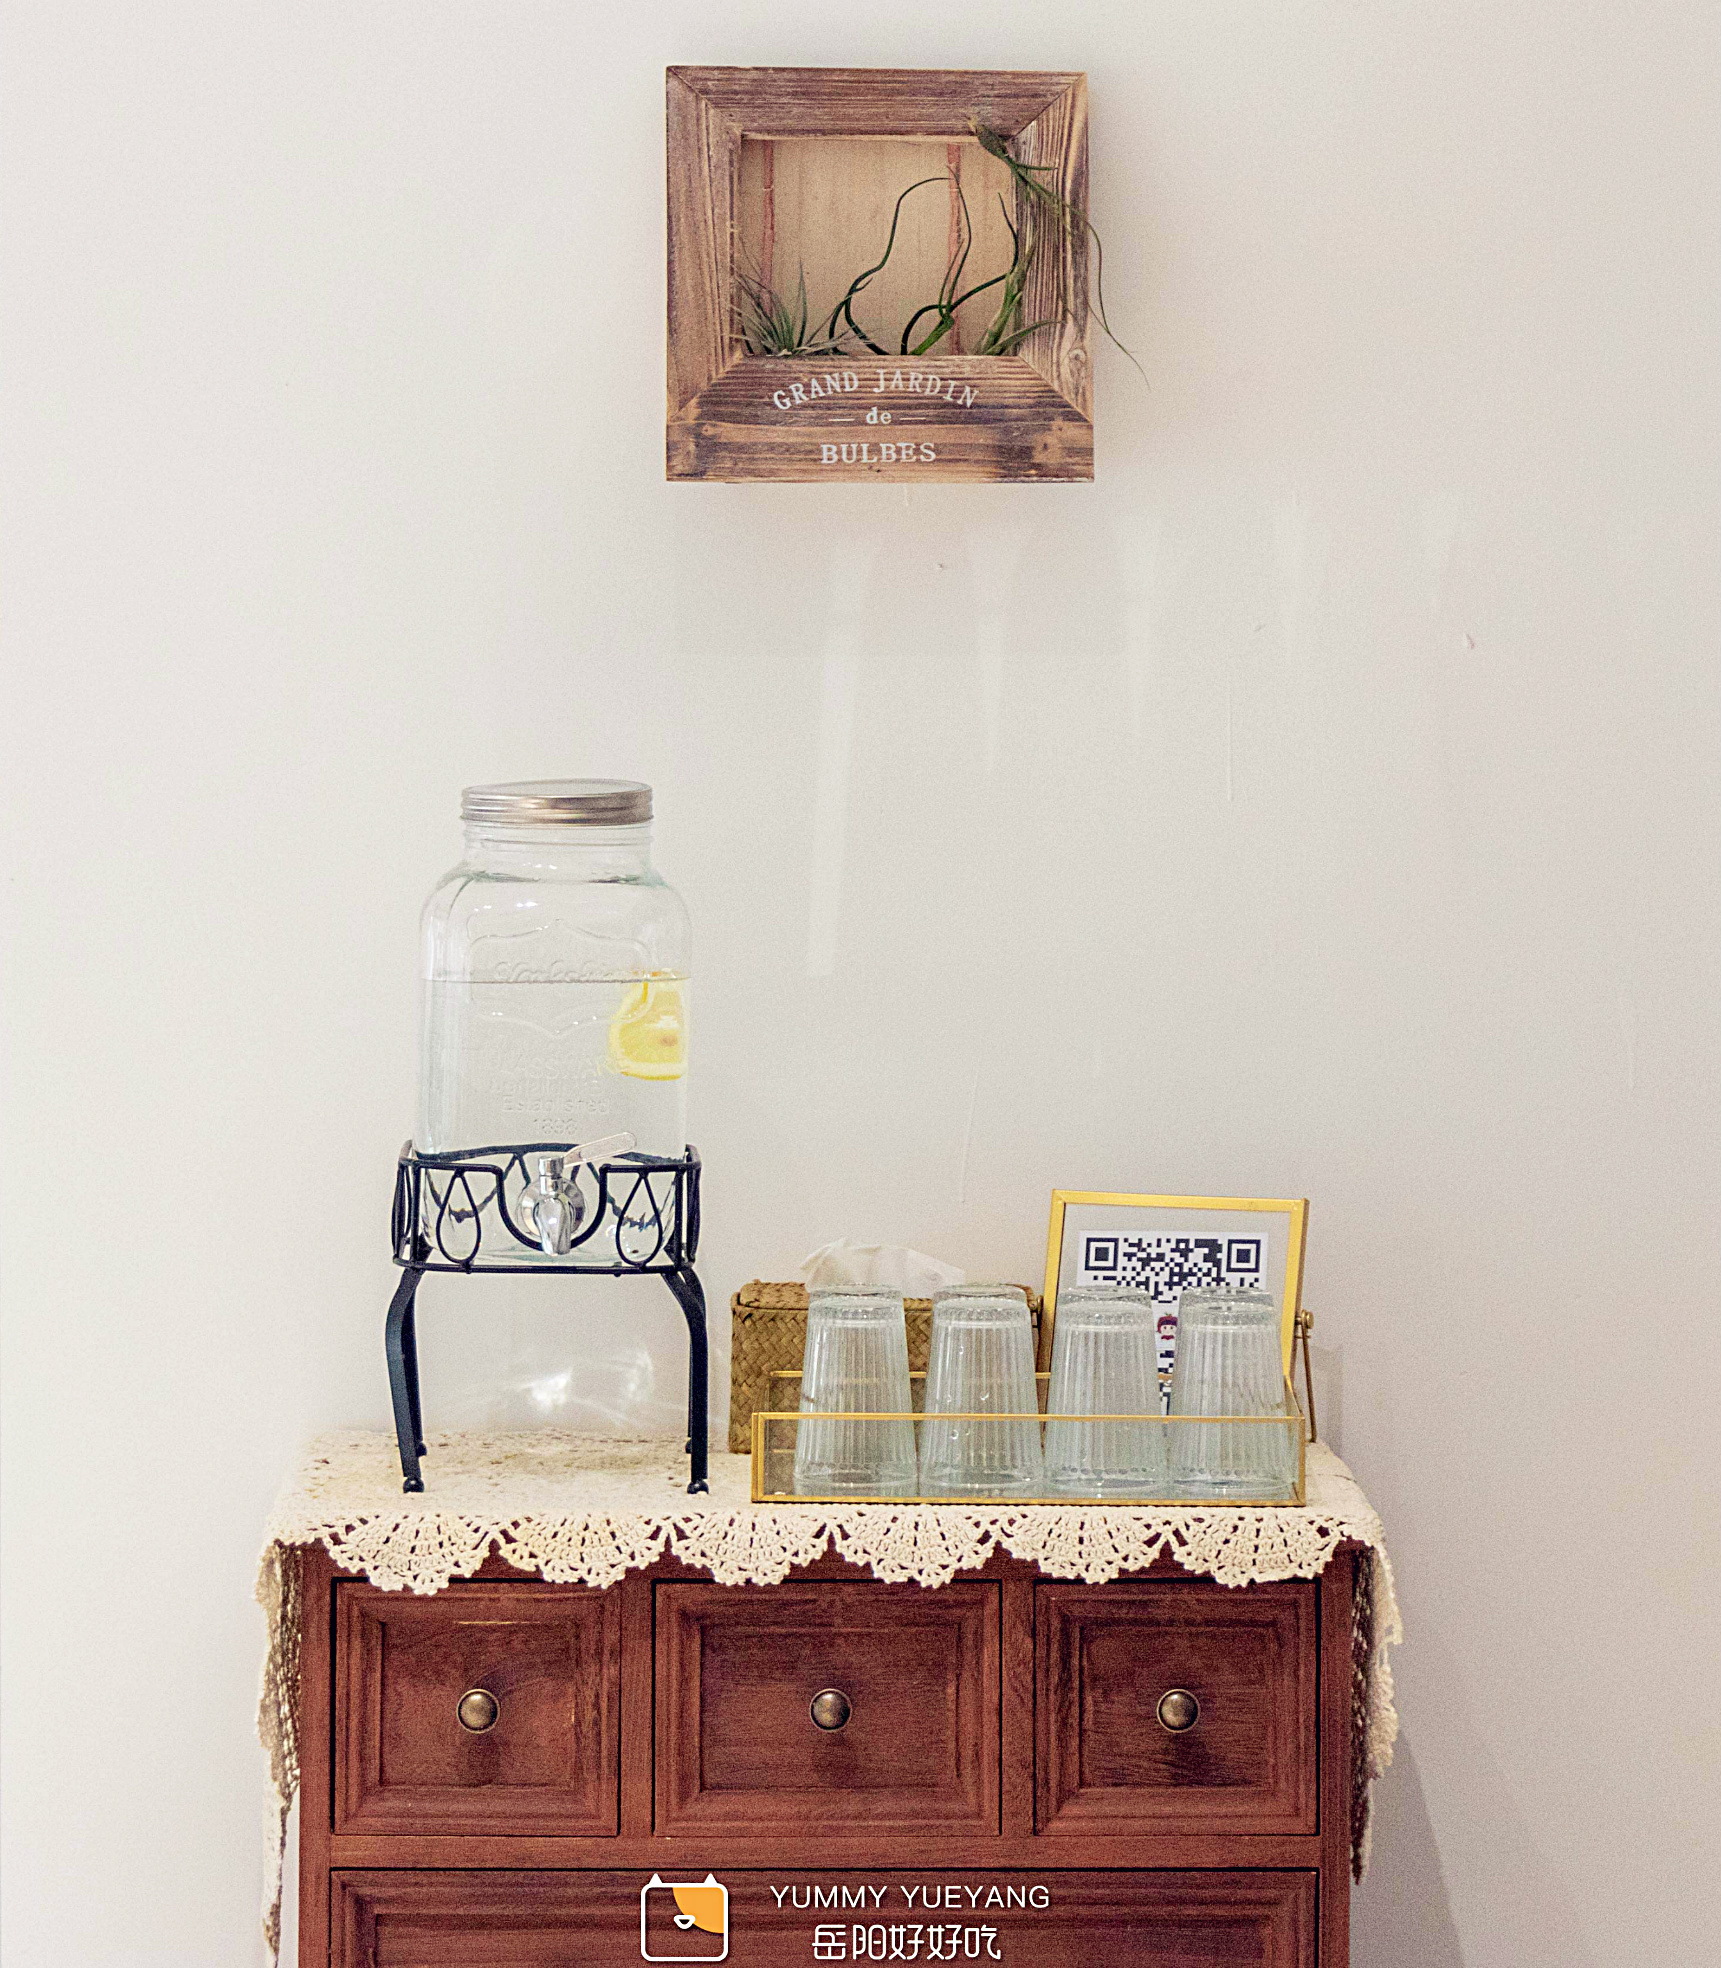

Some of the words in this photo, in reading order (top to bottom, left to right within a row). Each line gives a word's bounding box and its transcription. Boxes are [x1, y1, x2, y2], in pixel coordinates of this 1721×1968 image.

[773, 371, 859, 410] GRAND
[873, 369, 979, 408] JARDIN
[866, 406, 892, 425] de
[820, 442, 937, 464] BULBES
